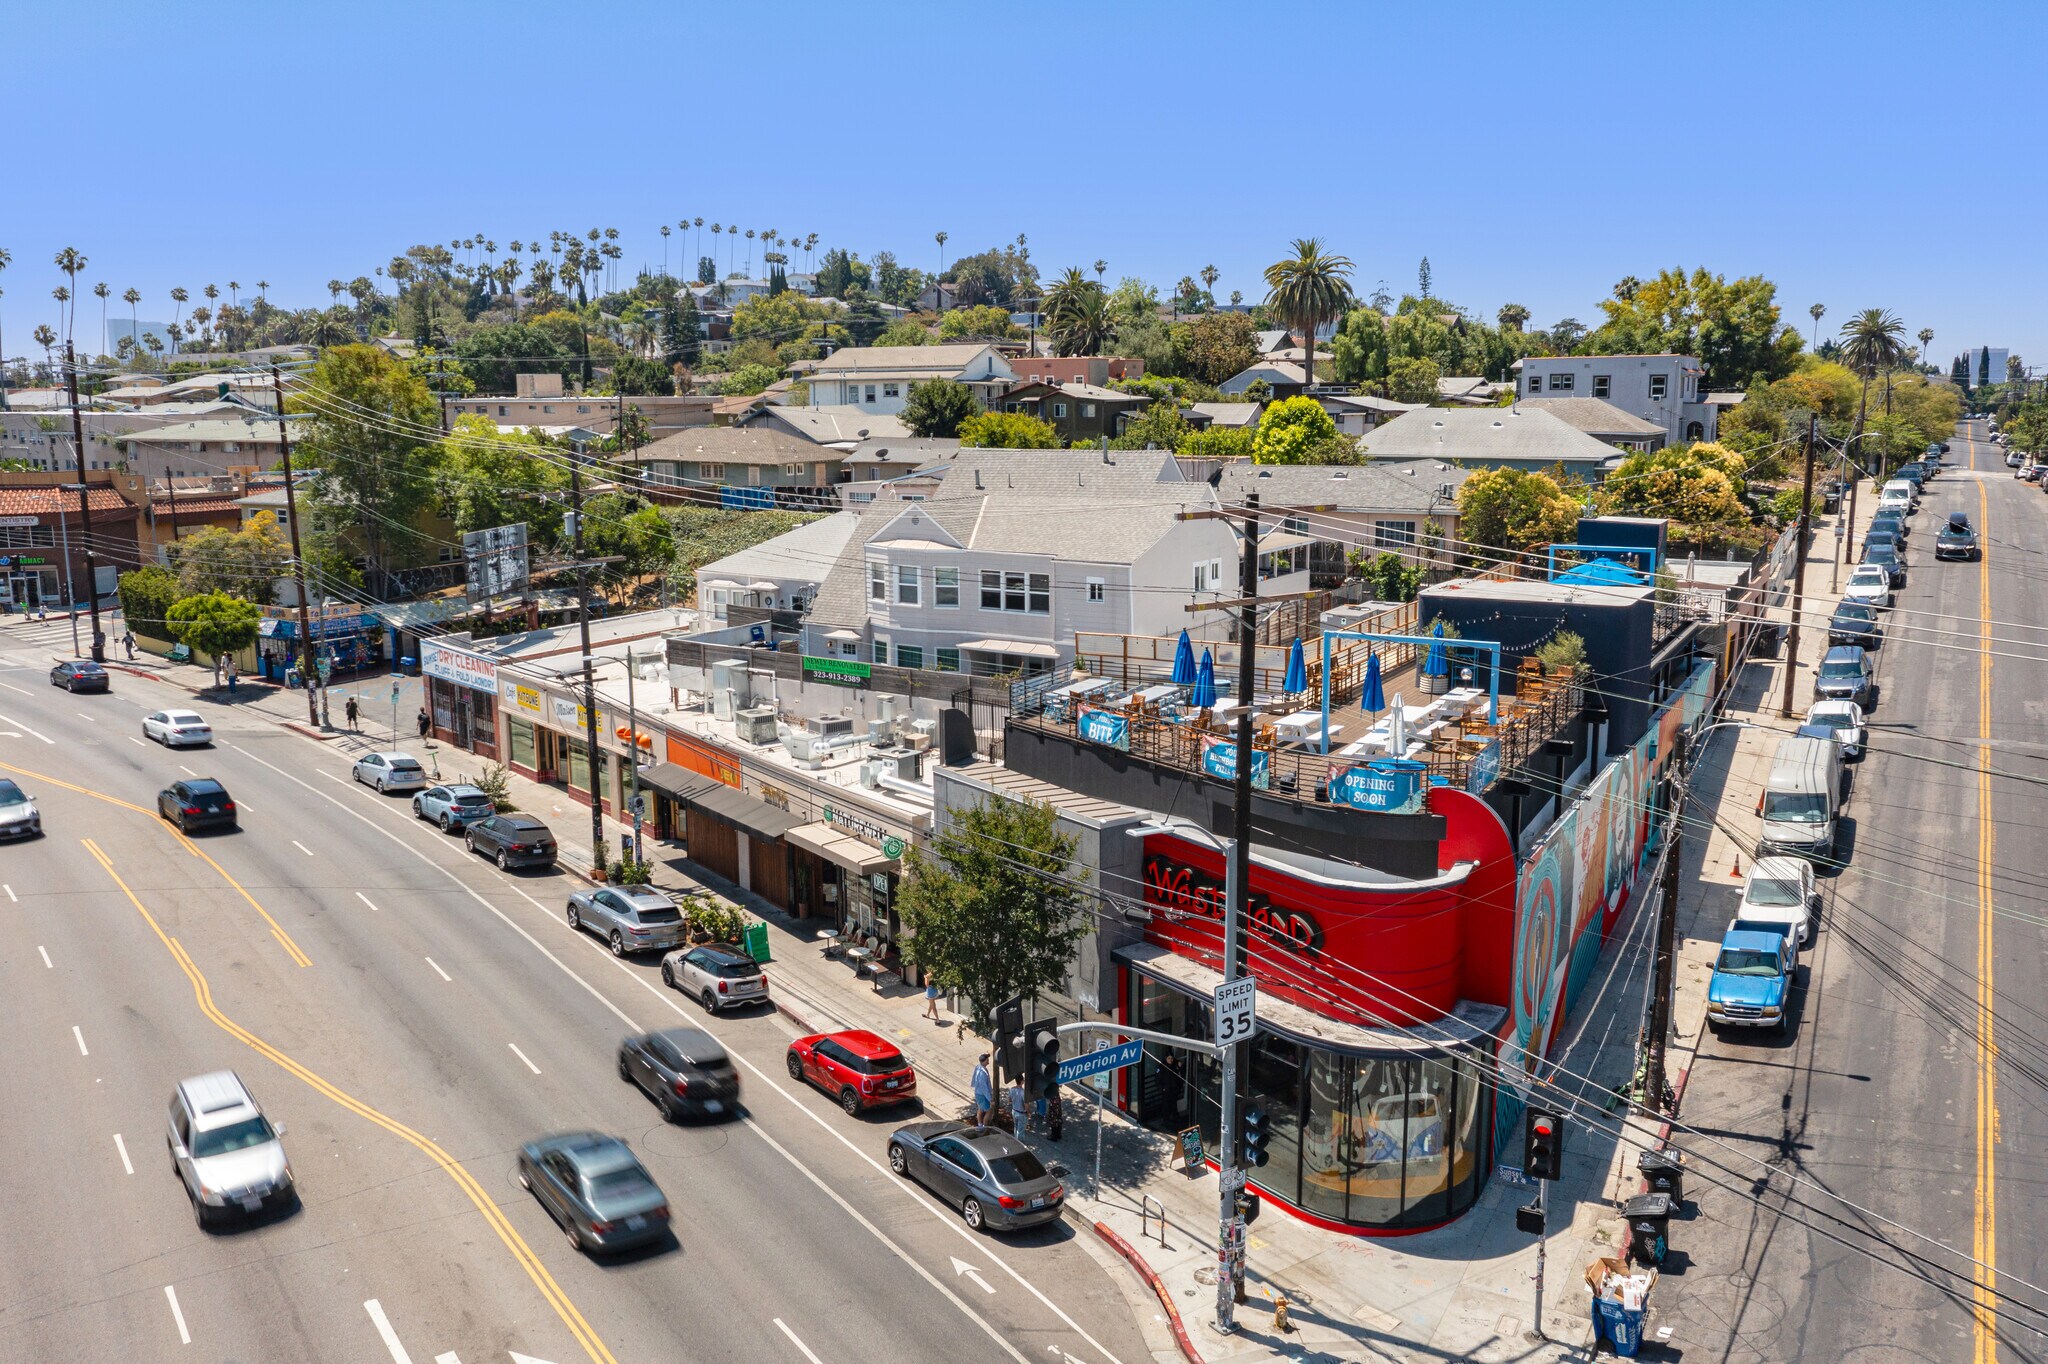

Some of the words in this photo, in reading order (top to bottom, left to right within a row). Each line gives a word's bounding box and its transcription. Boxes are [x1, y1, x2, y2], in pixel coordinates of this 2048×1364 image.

[438, 649, 454, 666] DRY
[455, 653, 495, 678] CLEANING
[805, 657, 827, 667] NEWLY
[828, 658, 869, 672] RENOVATED!
[434, 664, 450, 675] FLUFF
[455, 670, 470, 682] FOLD
[813, 670, 861, 683] 323-913-2389
[556, 702, 576, 716] Maison
[1088, 722, 1113, 744] BITE
[1225, 747, 1237, 758] YOU
[1345, 774, 1395, 792] OPENING
[1353, 791, 1387, 806] SOON
[1218, 983, 1253, 1001] SPEED
[1222, 997, 1249, 1014] LIMIT
[1220, 1010, 1251, 1040] 35
[1058, 1054, 1117, 1080] Hyperion
[1120, 1047, 1137, 1062] Av
[1499, 1167, 1523, 1180] Sunset
